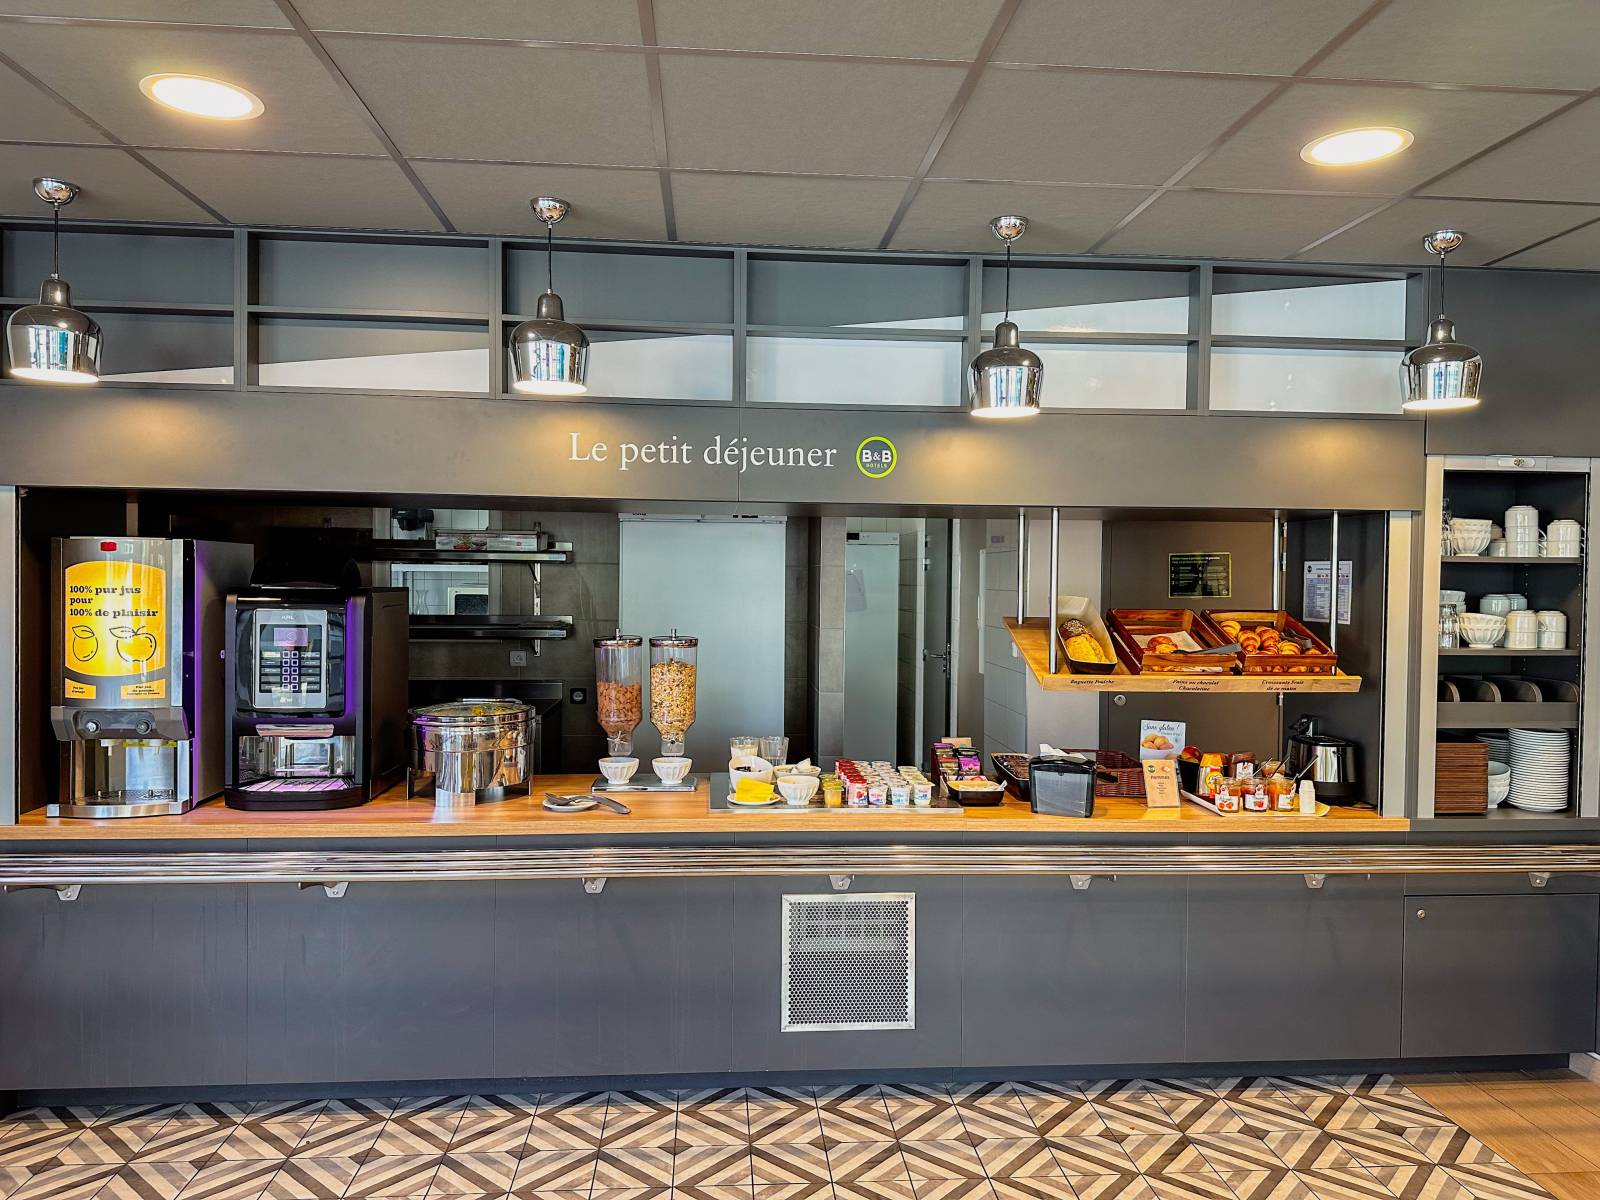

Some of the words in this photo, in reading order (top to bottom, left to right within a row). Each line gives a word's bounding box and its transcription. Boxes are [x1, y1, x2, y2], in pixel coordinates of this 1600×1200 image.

[568, 432, 608, 462] Le
[619, 435, 693, 470] petit
[703, 435, 837, 473] déjeuner
[862, 449, 892, 463] B&B
[70, 585, 92, 593] 100%
[95, 587, 117, 595] pur
[119, 586, 141, 596] jus
[70, 597, 93, 605] pour
[70, 608, 92, 616] 100%
[112, 609, 158, 618] plaisir
[1143, 722, 1158, 731] Sans
[1158, 723, 1175, 732] gluten
